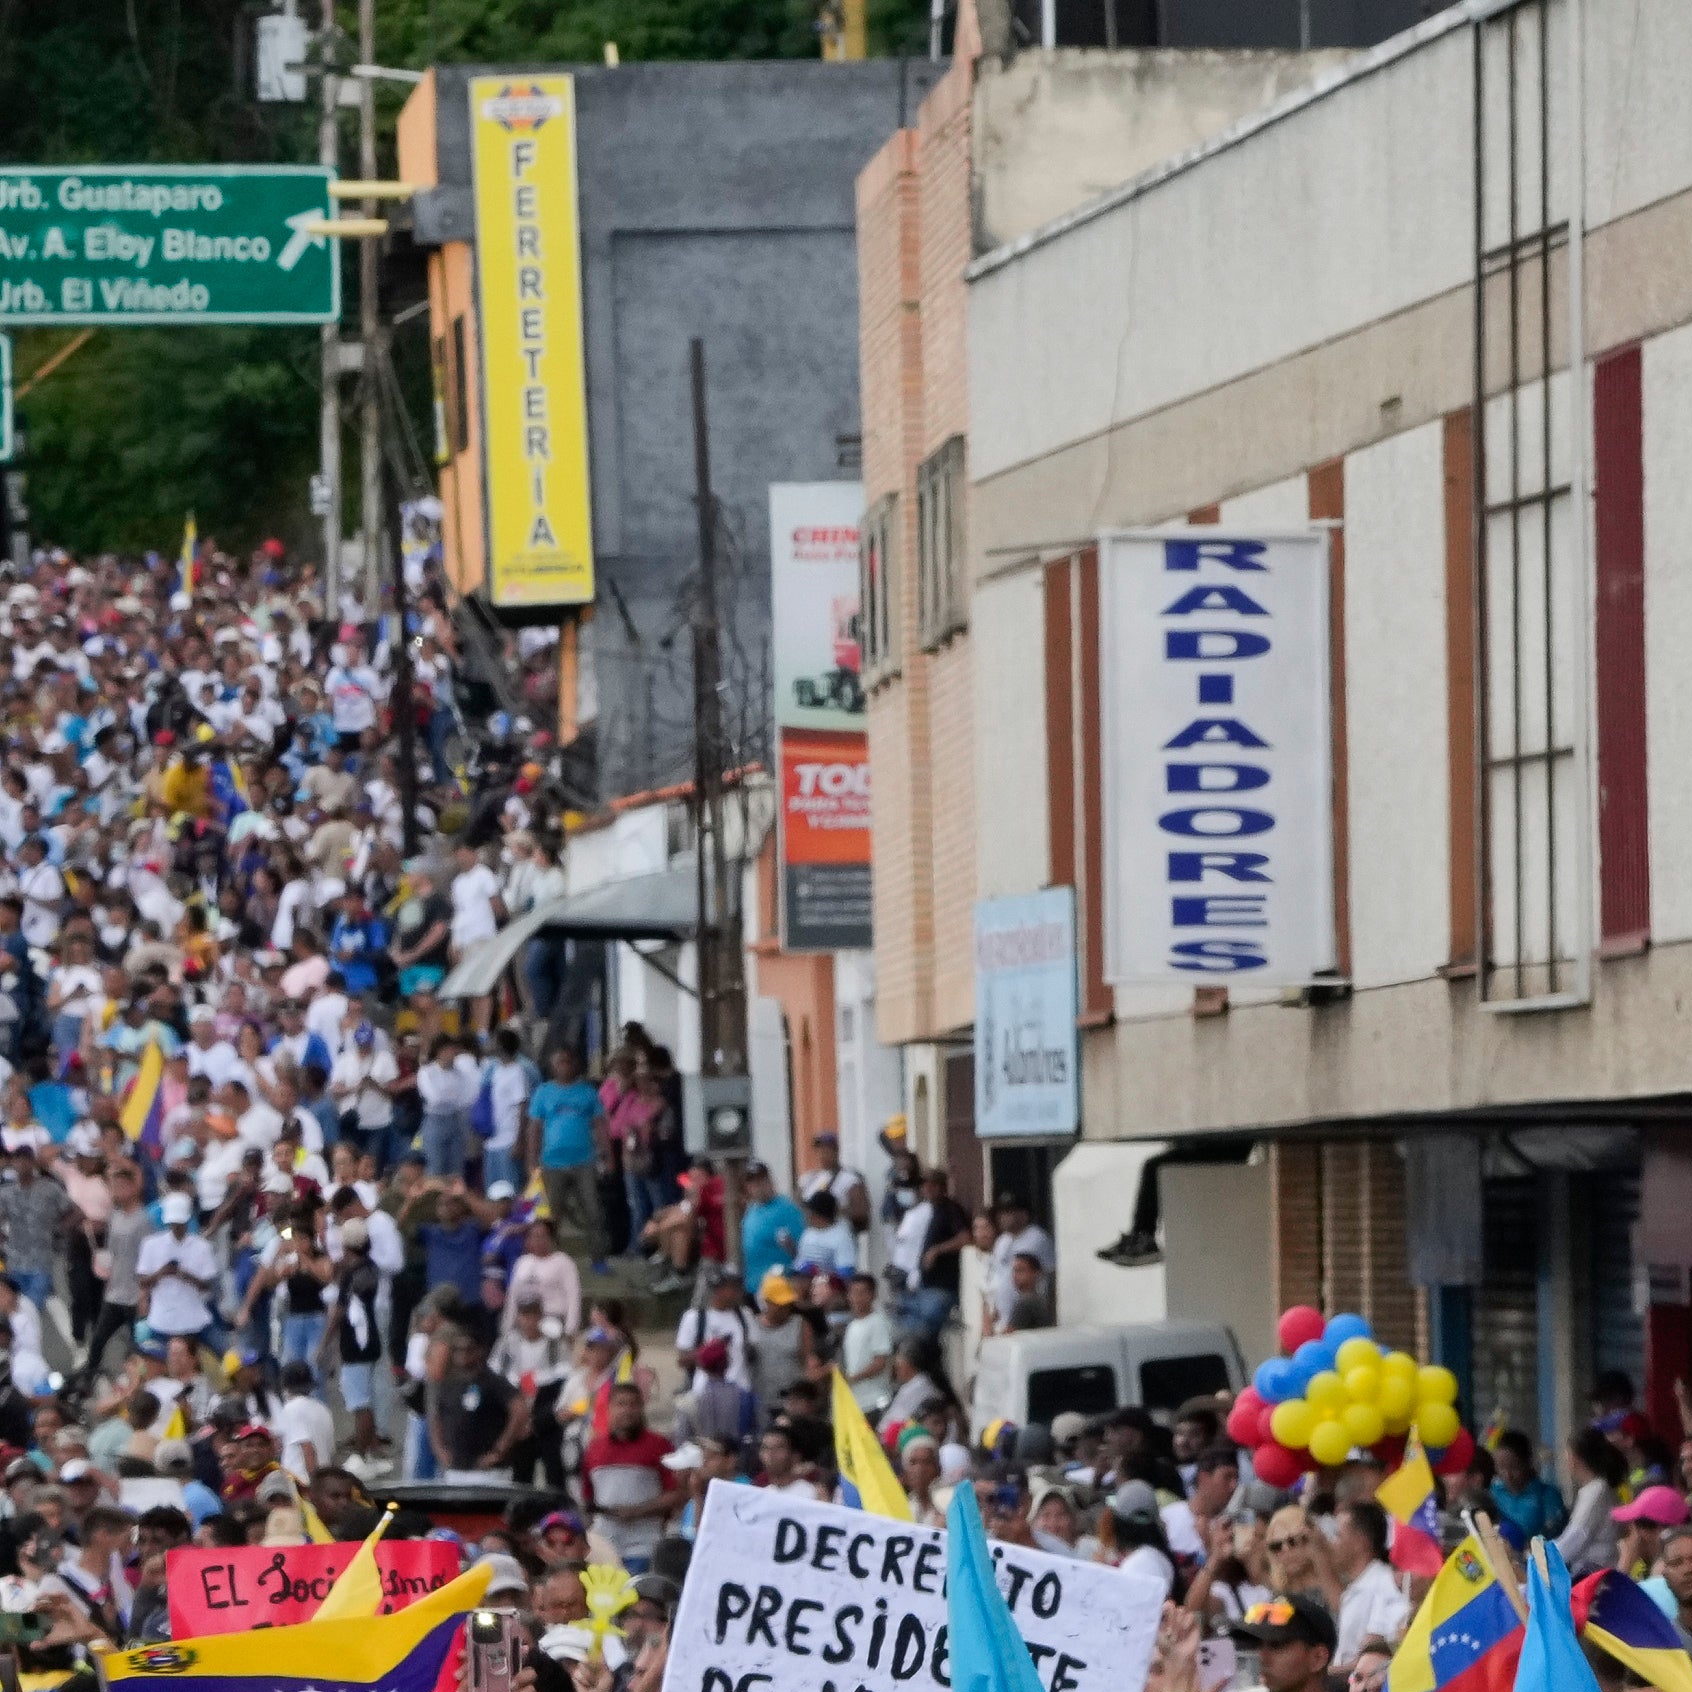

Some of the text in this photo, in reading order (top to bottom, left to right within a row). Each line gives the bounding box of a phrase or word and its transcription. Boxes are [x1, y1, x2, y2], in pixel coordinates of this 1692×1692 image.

[58, 177, 224, 218] Guataparo
[43, 226, 76, 260] A.
[84, 225, 155, 269] Eloy
[162, 227, 271, 262] Blanco
[61, 277, 93, 312] El
[100, 277, 211, 312] Viñedo
[513, 141, 558, 548] FERRETERIA
[1158, 540, 1275, 973] RADIADORES
[201, 1564, 250, 1609] EL
